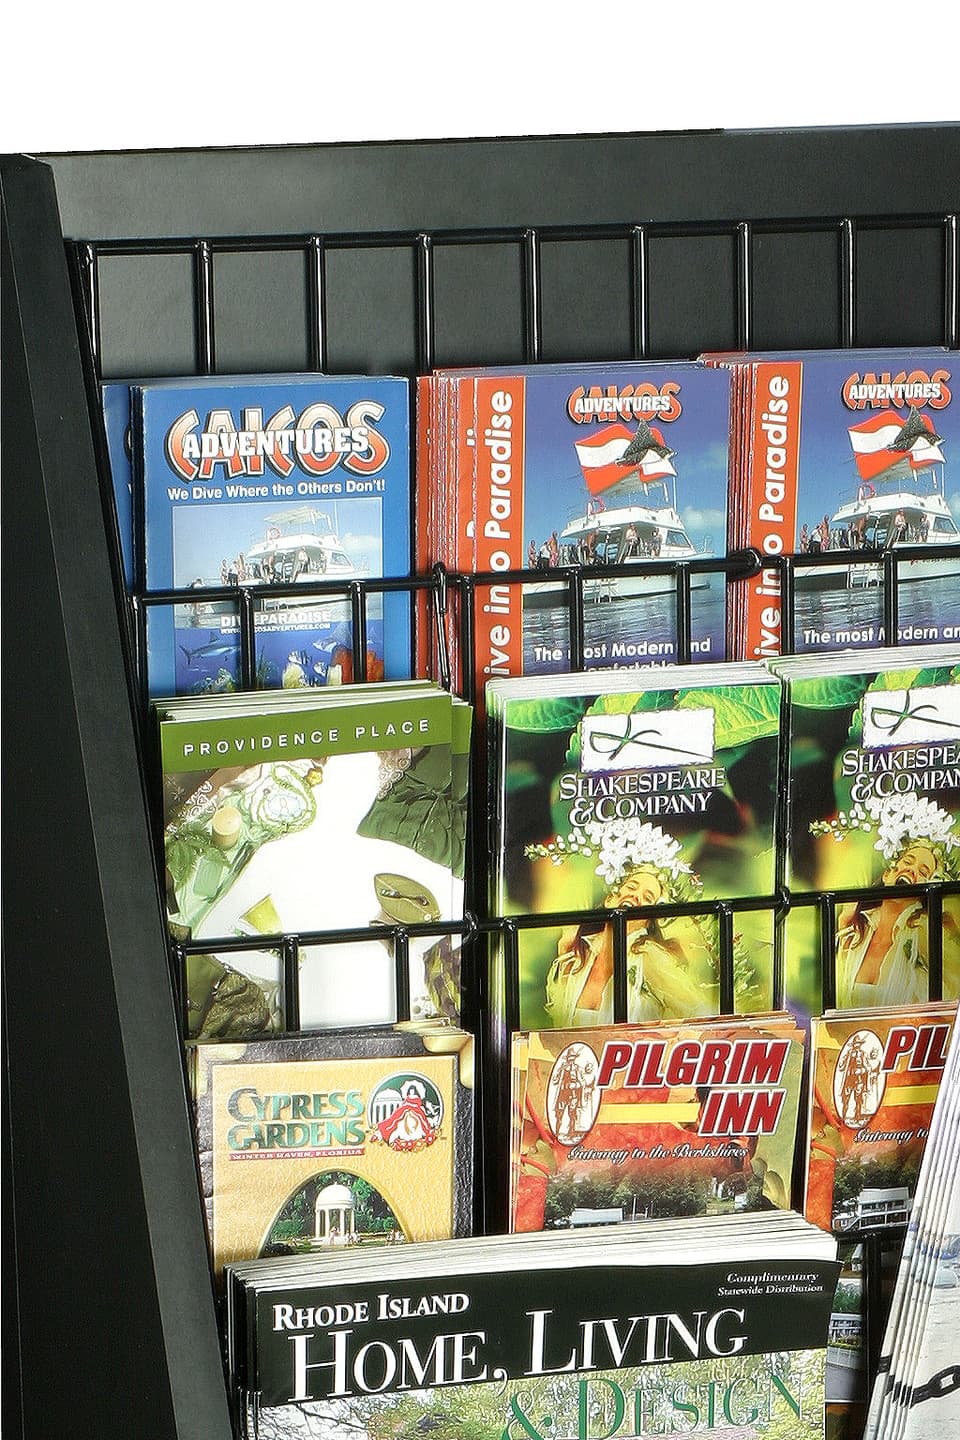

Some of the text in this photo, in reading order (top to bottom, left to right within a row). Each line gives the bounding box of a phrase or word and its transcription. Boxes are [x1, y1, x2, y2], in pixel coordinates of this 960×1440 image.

[568, 382, 683, 424] CAICOS
[574, 395, 671, 414] ADVENTURES
[165, 399, 390, 484] CAICOS
[182, 426, 370, 460] ADVENTURES
[483, 390, 514, 539] Paradise
[167, 478, 386, 501] We Dive Where the Others Don't!
[534, 637, 673, 662] The Modern
[184, 718, 430, 757] PROVIDENCE PLACE
[560, 767, 726, 801] SHAKESPEARE
[596, 1039, 791, 1089] PILGRIM
[227, 1087, 367, 1122] CYPRESS
[697, 1088, 787, 1137] INN
[227, 1119, 367, 1151] GARDENS
[716, 1284, 764, 1297] Statewide
[272, 1293, 470, 1332] RHODE ISLAND
[287, 1308, 749, 1402] HOME, LIVING
